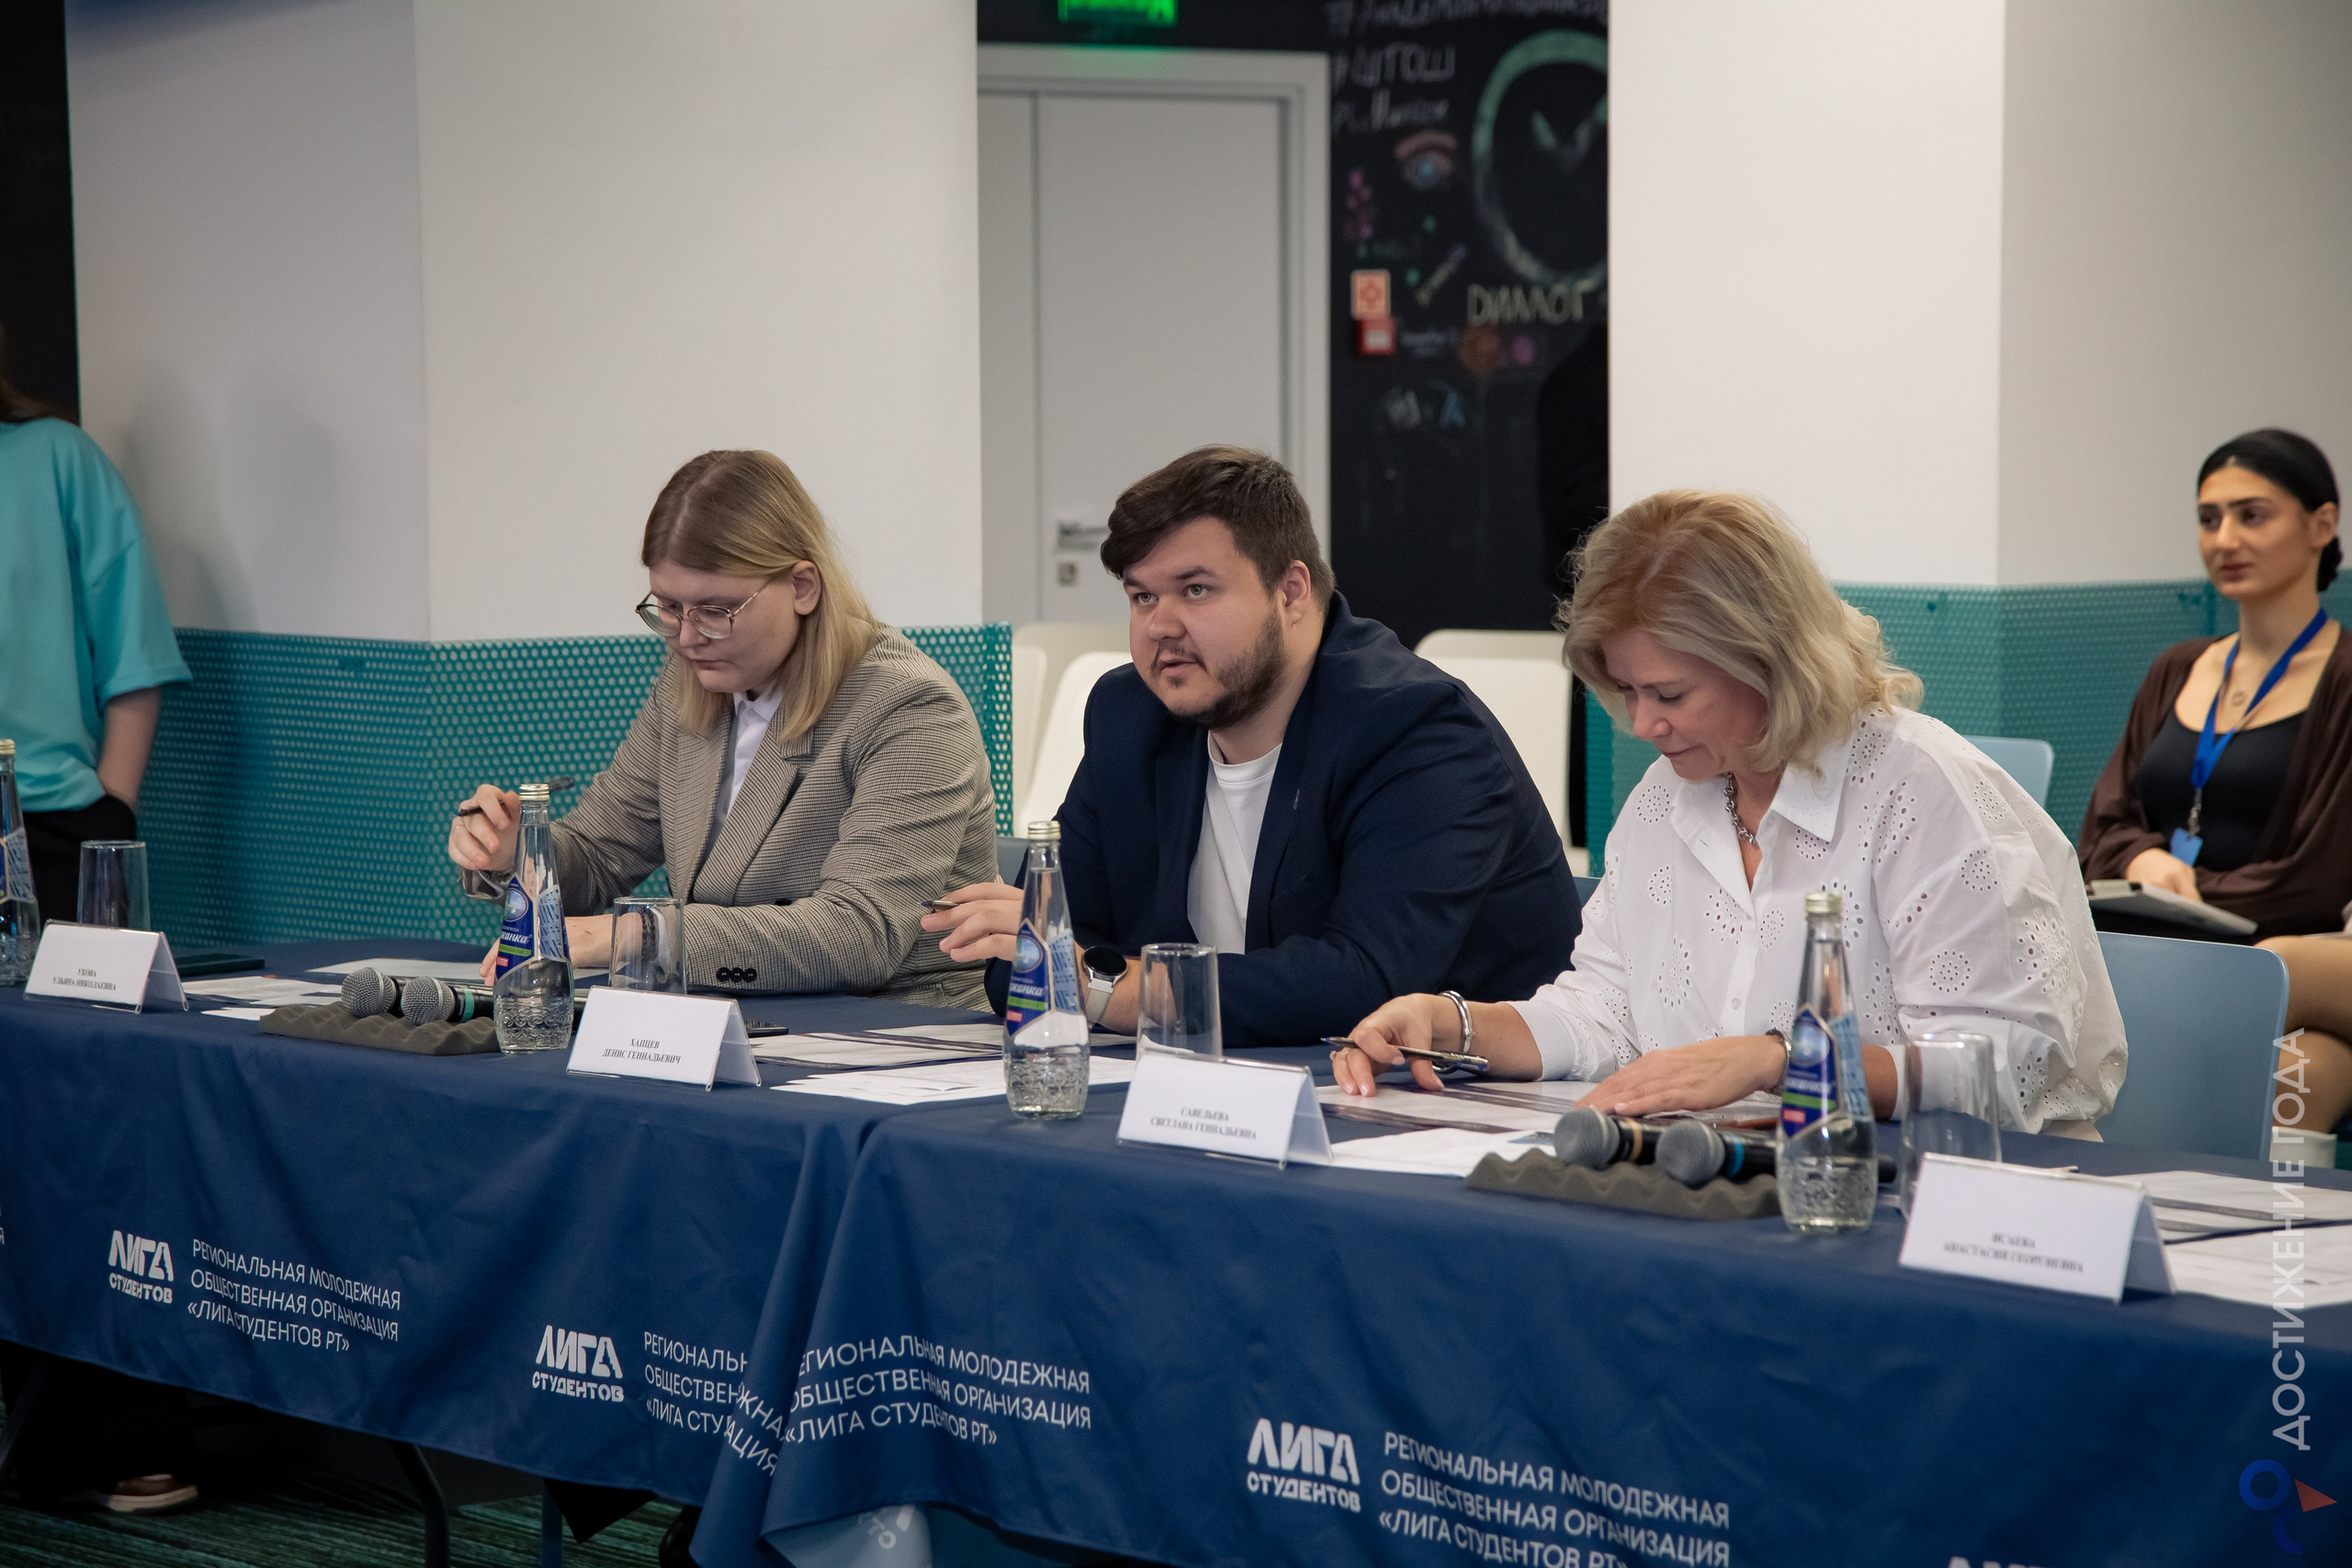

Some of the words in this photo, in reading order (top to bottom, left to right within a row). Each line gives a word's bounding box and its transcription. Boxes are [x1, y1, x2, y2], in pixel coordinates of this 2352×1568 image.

[602, 1048, 627, 1059] ДЕНИС
[627, 1050, 681, 1064] ГЕННАДЬЕВИЧ
[629, 1038, 661, 1049] ХАПЦЕВ
[1150, 1116, 1193, 1131] СВЕТЛАНА
[1194, 1122, 1257, 1140] ГЕННАДЬЕВНА
[1181, 1107, 1229, 1122] САВЕЛЬЕВА
[108, 1230, 174, 1281] ЛИГА
[193, 1238, 305, 1283] РЕГИОНАЛЬНАЯ
[309, 1266, 401, 1311] МОЛОДЕЖНАЯ
[108, 1272, 173, 1303] СТУДЕНТОВ
[190, 1269, 307, 1314] ОБЩЕСТВЕННАЯ
[311, 1298, 399, 1341] ОРГАНИЗАЦИЯ
[325, 1330, 350, 1352] РТ»
[535, 1325, 624, 1379] ЛИГА
[532, 1371, 625, 1403] СТУДЕНТОВ
[950, 1348, 1090, 1394] МОЛОДЕЖНАЯ
[646, 1398, 684, 1428] «ЛИГА
[785, 1410, 865, 1443] «ЛИГА
[871, 1402, 968, 1439] СТУДЕНТОВ
[971, 1423, 998, 1446] РТ»
[955, 1383, 1091, 1429] ОРГАНИЗАЦИЯ
[1247, 1418, 1361, 1485] ЛИГА
[1247, 1472, 1361, 1513] СТУДЕНТОВ
[1385, 1431, 1554, 1493] РЕГИОНАЛЬНАЯ
[1561, 1472, 1729, 1530] МОЛОДЕЖНАЯ
[1378, 1508, 1451, 1543] «ЛИГА
[1453, 1524, 1580, 1568] СТУДЕНТОВ
[1381, 1470, 1555, 1531] ОБЩЕСТВЕННАЯ
[1564, 1507, 1729, 1567] ОРГАНИЗАЦИЯ
